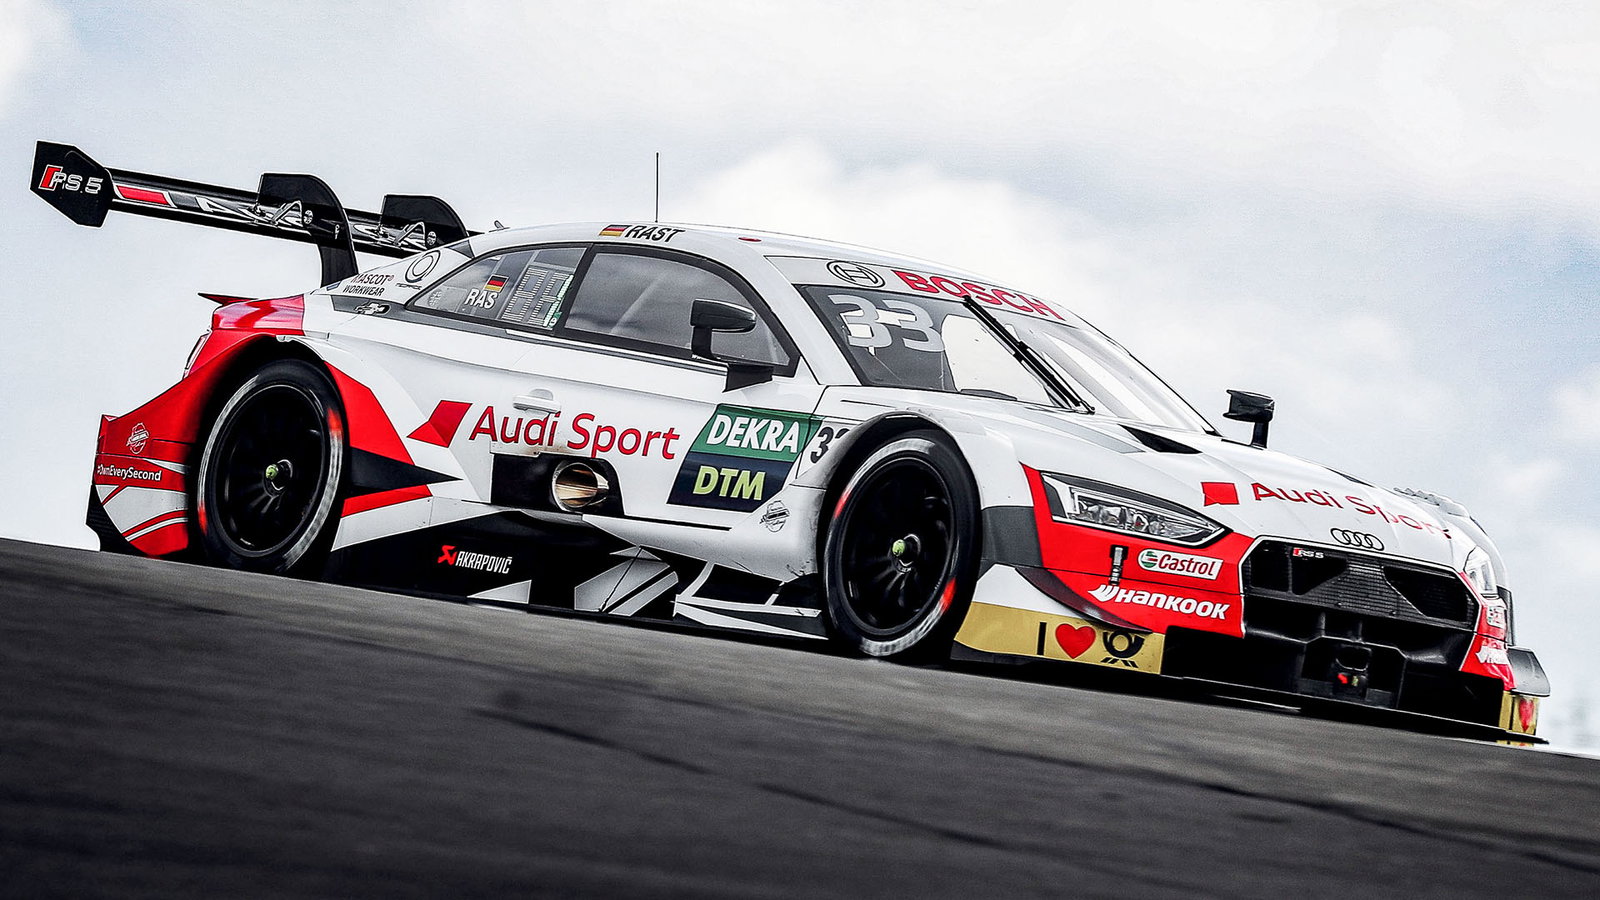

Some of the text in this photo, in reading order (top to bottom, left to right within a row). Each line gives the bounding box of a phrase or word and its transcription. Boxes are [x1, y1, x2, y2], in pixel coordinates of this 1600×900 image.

[624, 225, 686, 243] RAST
[342, 285, 386, 297] WORKWEAR
[891, 269, 1067, 322] BOSCH
[827, 294, 946, 353] 33
[468, 405, 681, 460] Audi Sport
[706, 414, 800, 454] DEKRA
[692, 465, 766, 501] DTM
[1251, 482, 1452, 540] Audi Sport
[1157, 553, 1216, 576] Castrol
